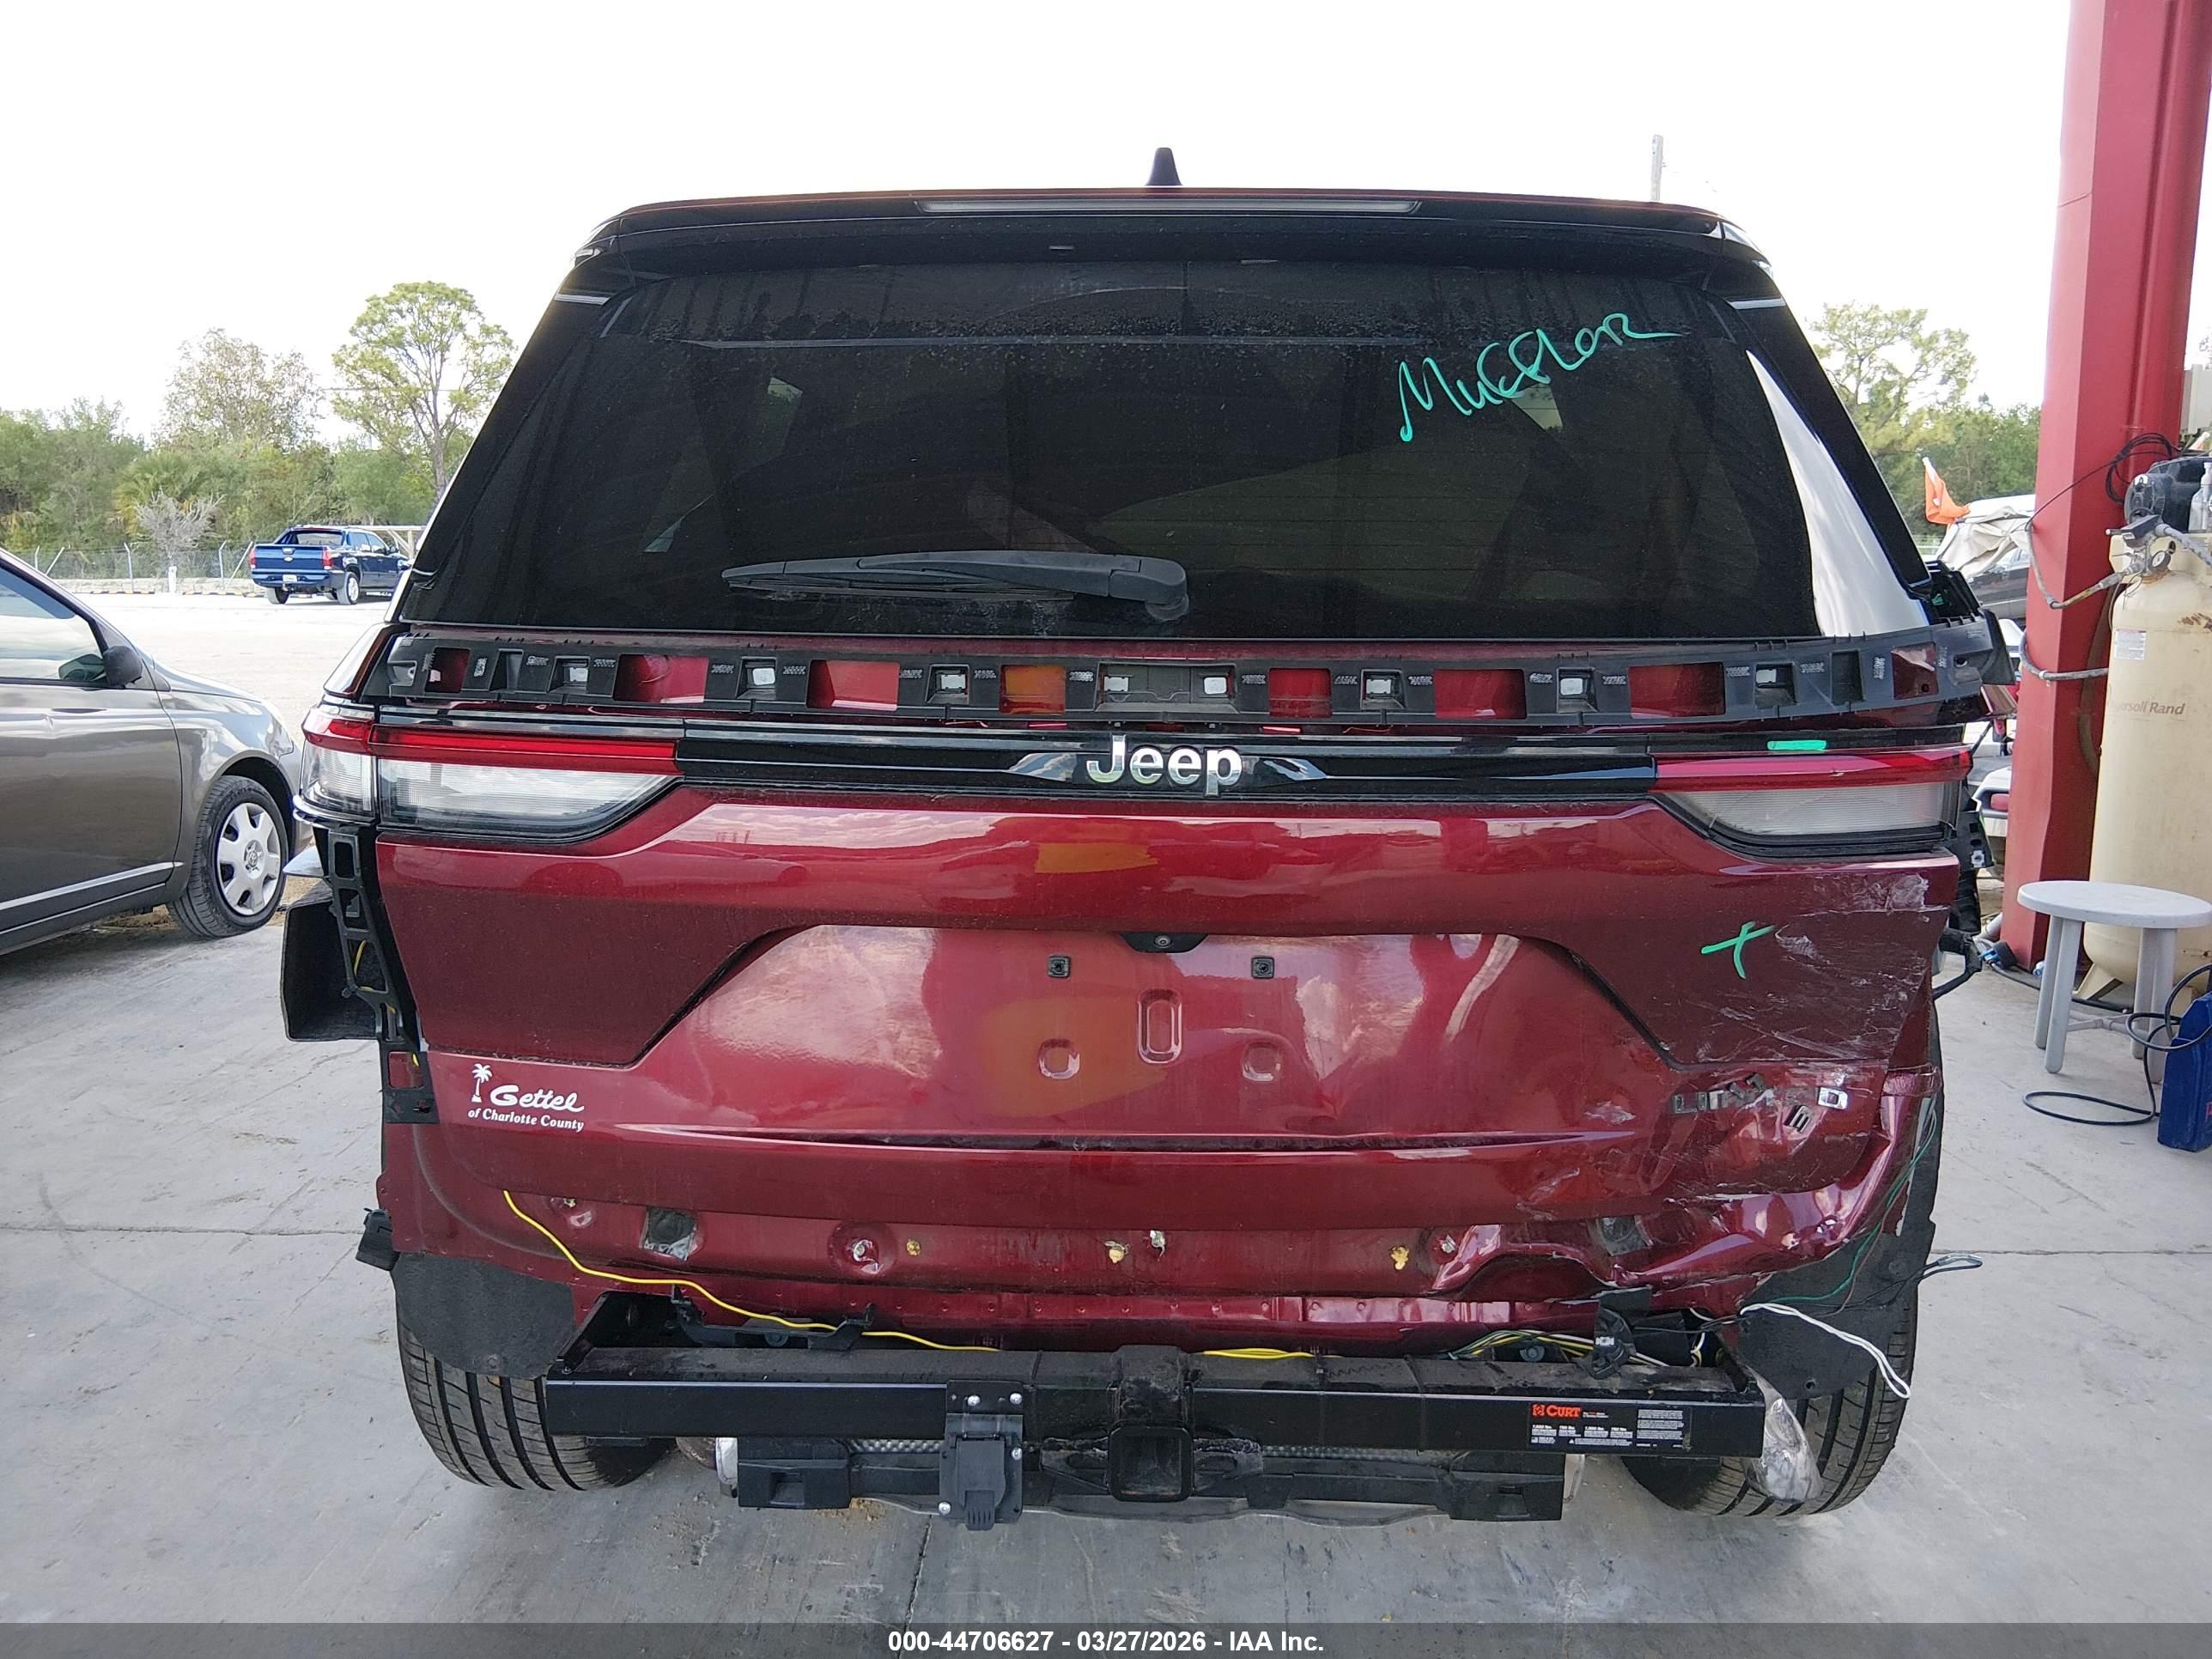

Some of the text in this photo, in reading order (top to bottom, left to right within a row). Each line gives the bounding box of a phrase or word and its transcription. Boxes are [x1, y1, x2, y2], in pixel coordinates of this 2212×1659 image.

[2149, 702, 2186, 715] Rand
[1085, 734, 1243, 797] Jeep
[489, 1084, 585, 1113] Gettel
[467, 1107, 585, 1133] of Charlotte County
[1546, 1404, 1581, 1418] CURT
